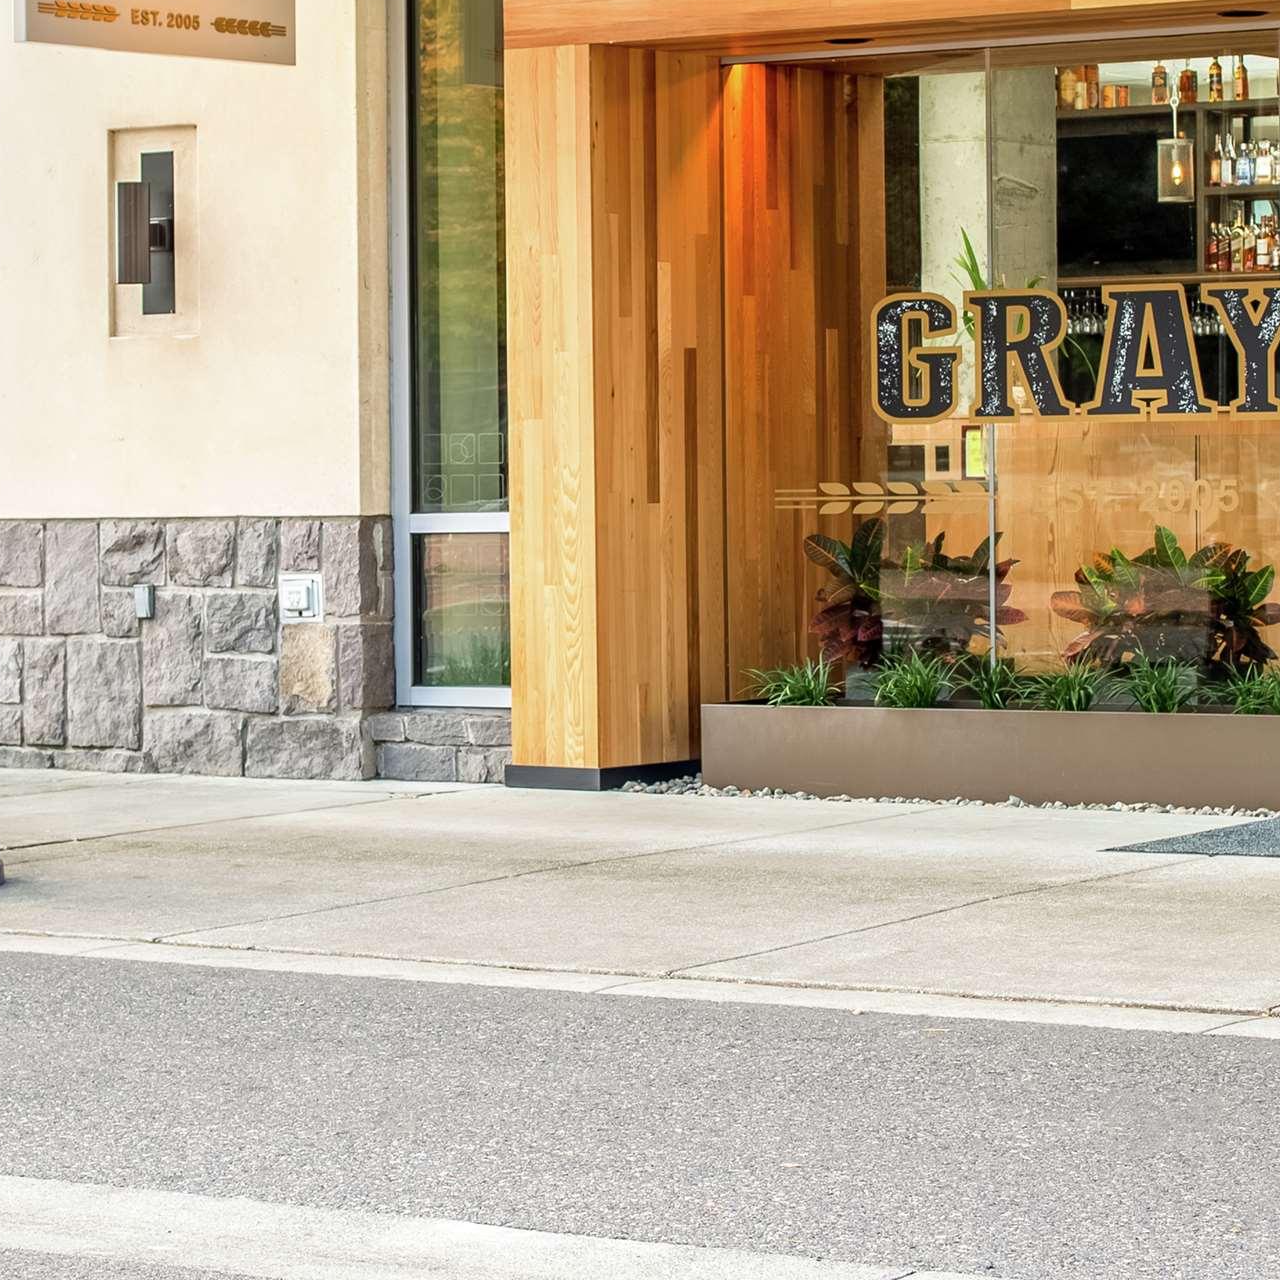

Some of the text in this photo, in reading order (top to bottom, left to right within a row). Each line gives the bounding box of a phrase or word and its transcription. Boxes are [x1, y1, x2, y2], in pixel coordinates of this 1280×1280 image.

[130, 8, 200, 30] EST. 2005
[1139, 478, 1240, 512] 2005
